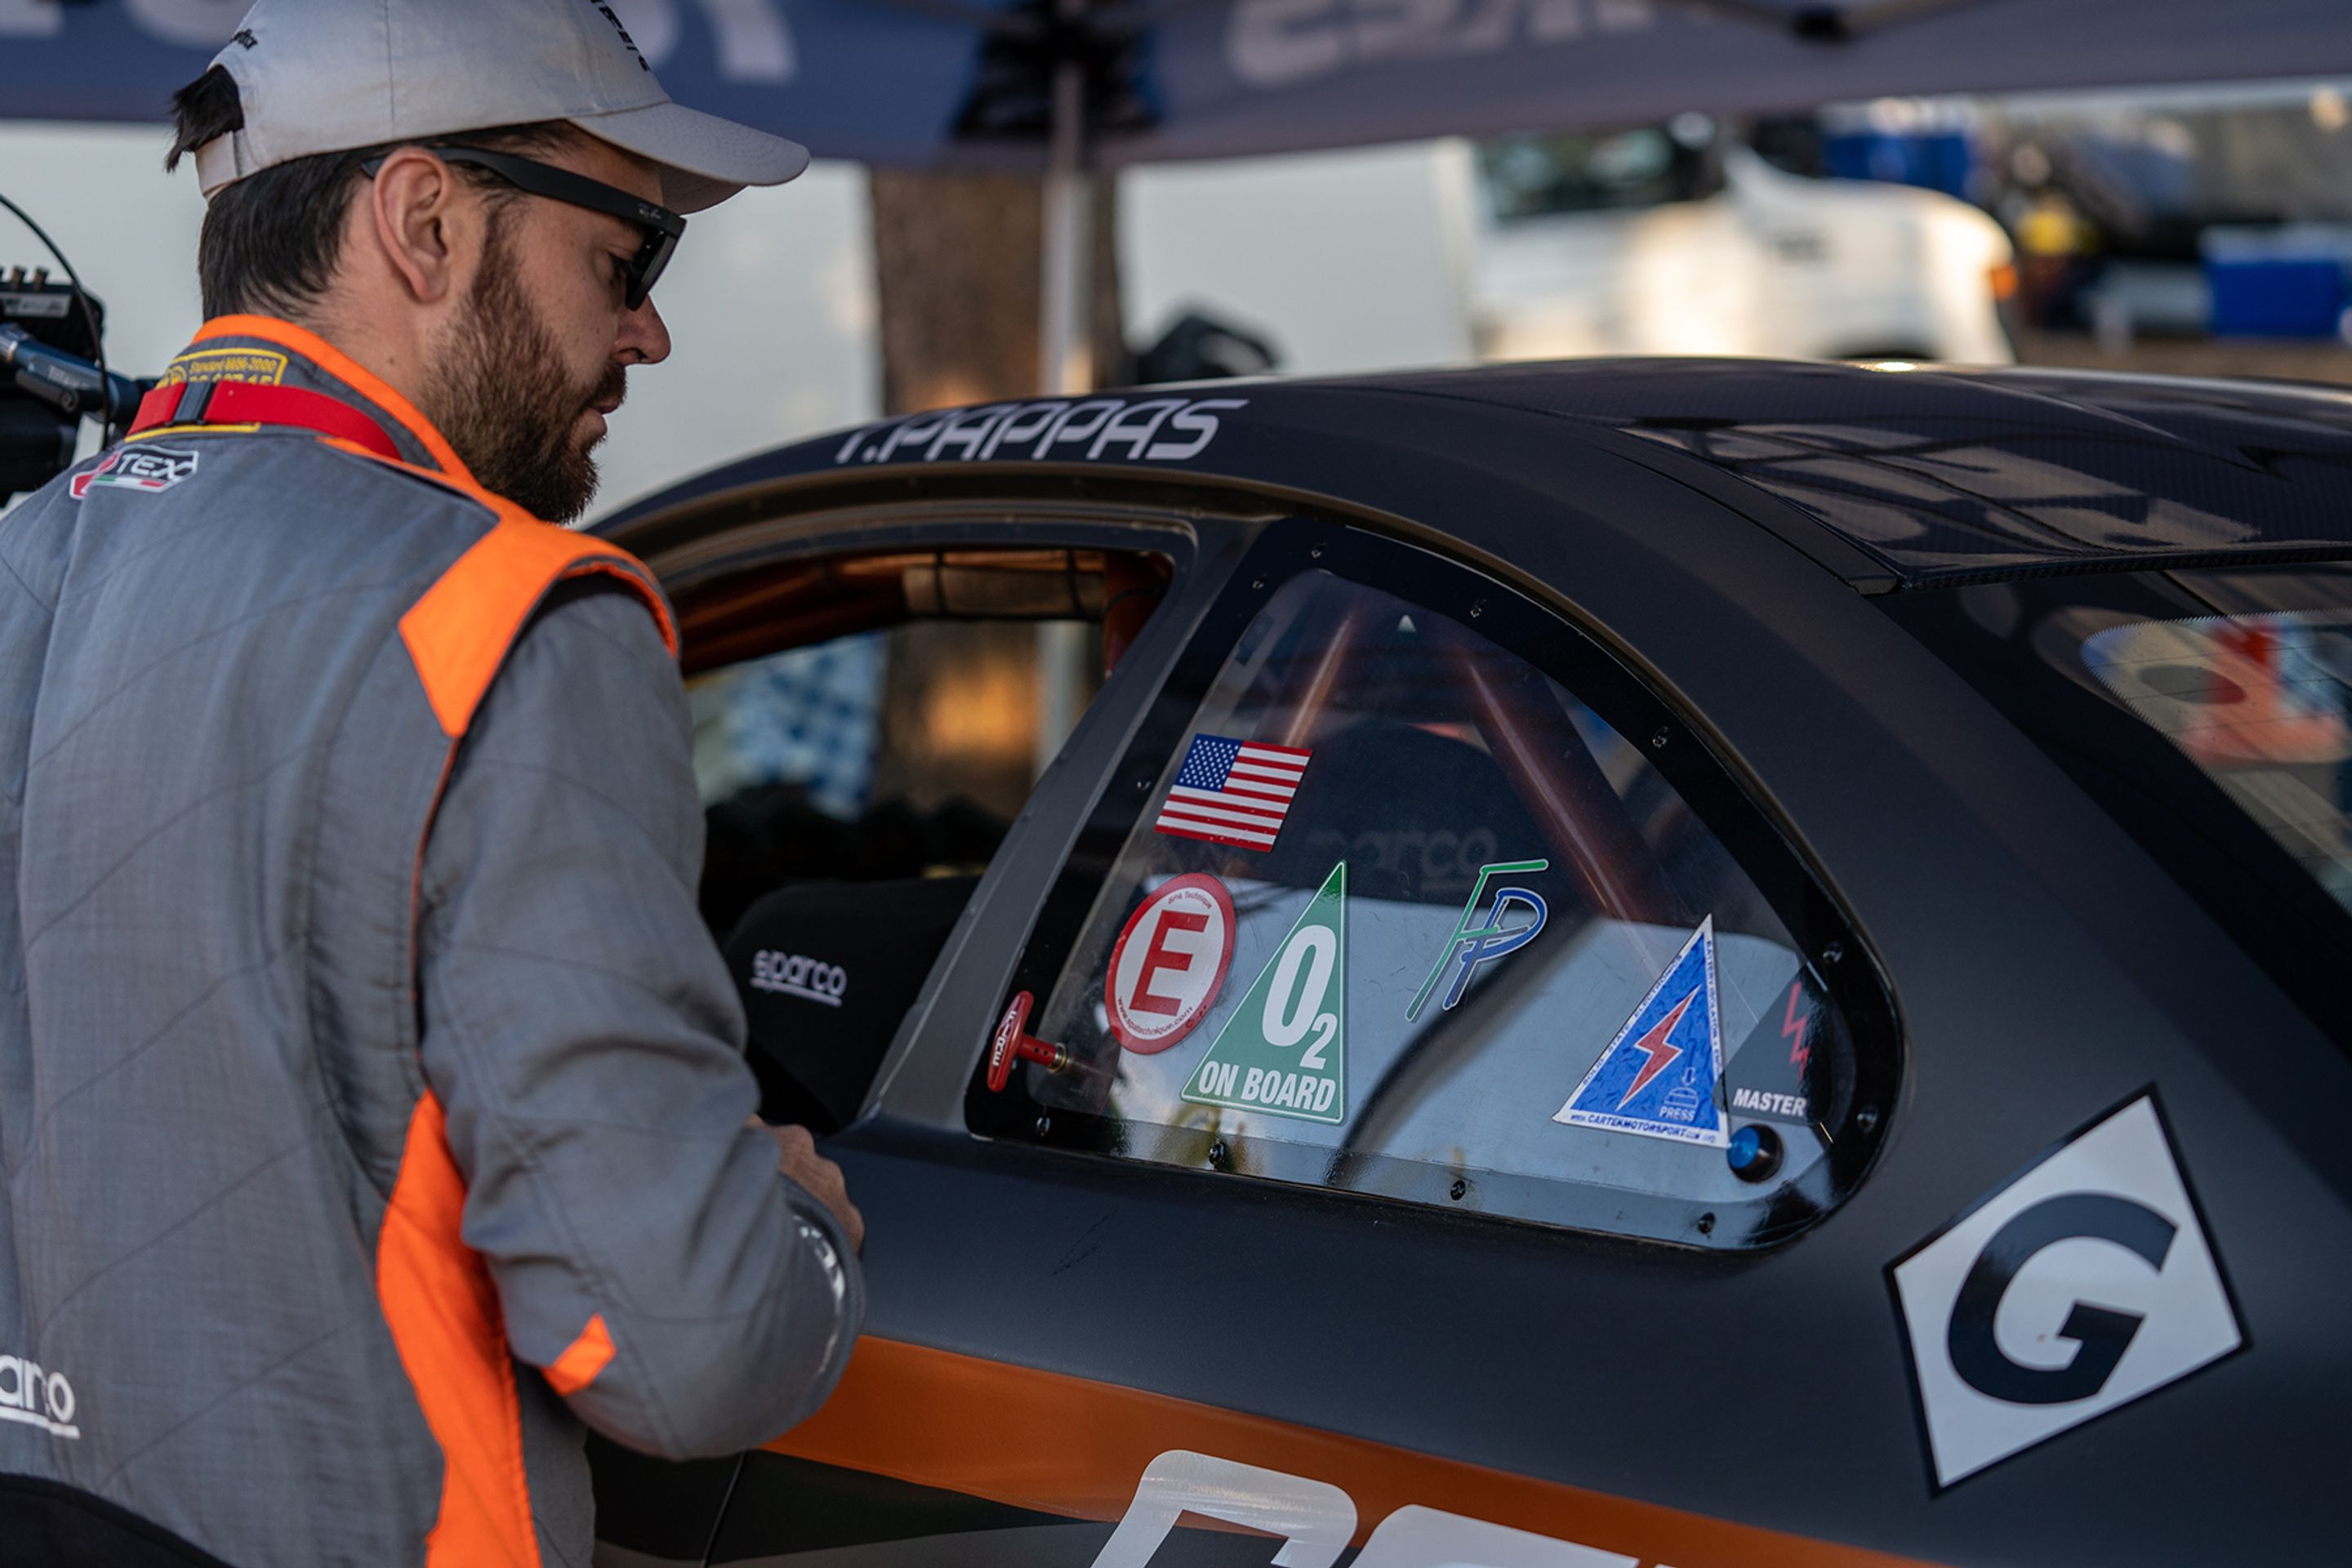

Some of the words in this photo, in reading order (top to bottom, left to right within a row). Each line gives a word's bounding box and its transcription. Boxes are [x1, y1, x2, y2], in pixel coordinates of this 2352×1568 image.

[751, 948, 848, 997] sparco
[1129, 909, 1210, 1017] E
[1198, 1061, 1240, 1098] ON
[1241, 1067, 1337, 1112] BOARD
[1732, 1087, 1807, 1117] MASTER
[1659, 1105, 1695, 1122] PRESS
[1947, 1191, 2180, 1406] G
[0, 1354, 76, 1424] aro
